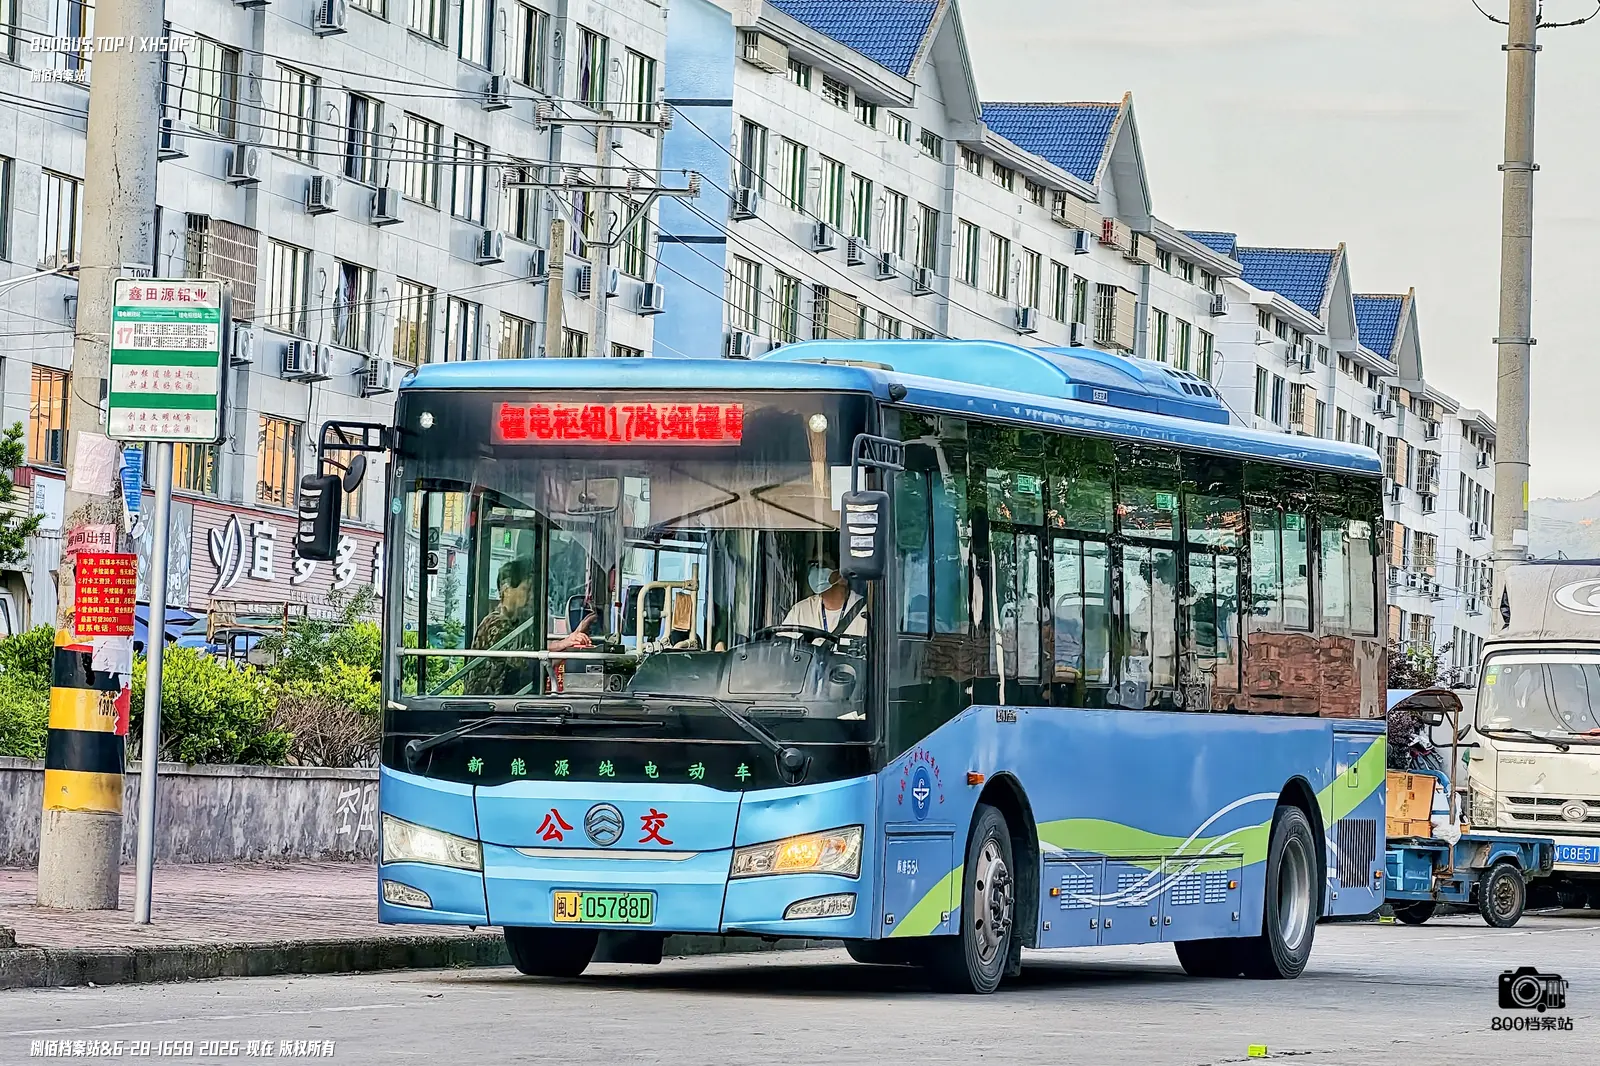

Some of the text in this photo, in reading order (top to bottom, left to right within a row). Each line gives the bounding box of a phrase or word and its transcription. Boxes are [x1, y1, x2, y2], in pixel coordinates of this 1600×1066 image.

[128, 286, 208, 302] 鑫田源铝业
[117, 327, 134, 344] 17
[467, 756, 752, 784] 新能源纯电动车
